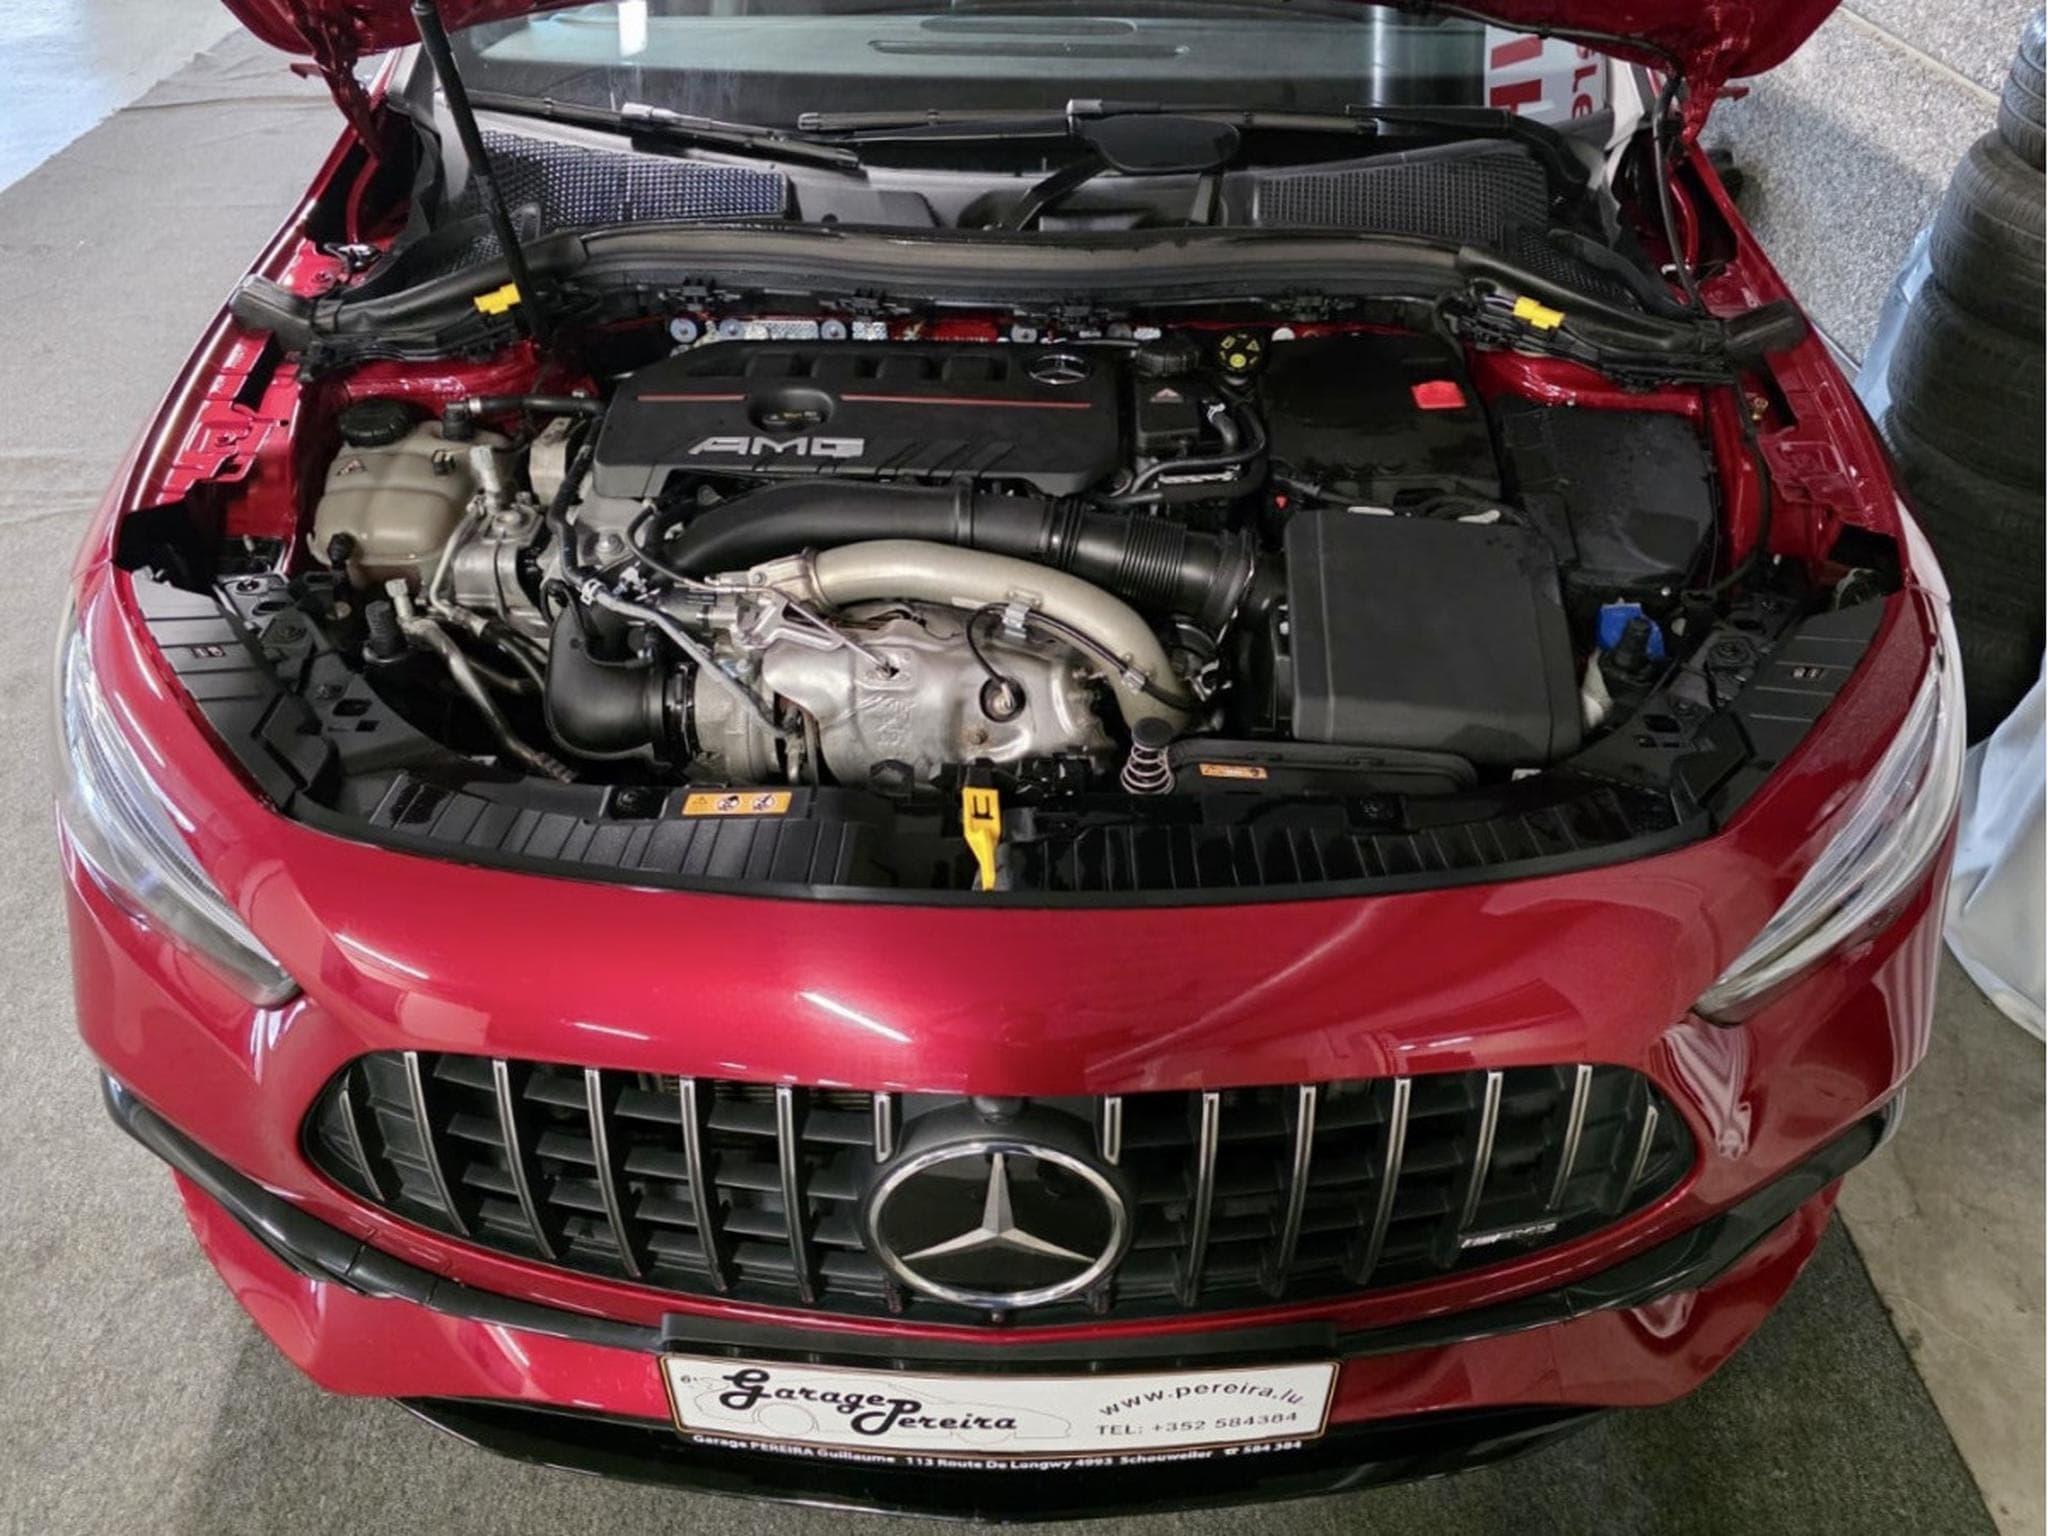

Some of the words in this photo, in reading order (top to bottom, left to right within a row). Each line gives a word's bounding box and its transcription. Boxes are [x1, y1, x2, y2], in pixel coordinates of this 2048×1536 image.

[688, 436, 865, 458] AMG
[719, 1369, 885, 1414] Garage
[1100, 1382, 1304, 1416] www.pereira.lu
[850, 1398, 1017, 1436] Pereira
[1096, 1424, 1143, 1436] TEL:
[1153, 1420, 1206, 1432] +352
[1215, 1412, 1298, 1429] 584384
[693, 1434, 748, 1449] Garage
[750, 1441, 814, 1456] PEREIRA
[816, 1448, 895, 1463] Guillaume
[905, 1456, 933, 1466] 113
[938, 1458, 982, 1469] Route
[1010, 1458, 1071, 1470] Longwy
[1120, 1450, 1213, 1466] Schouweiler
